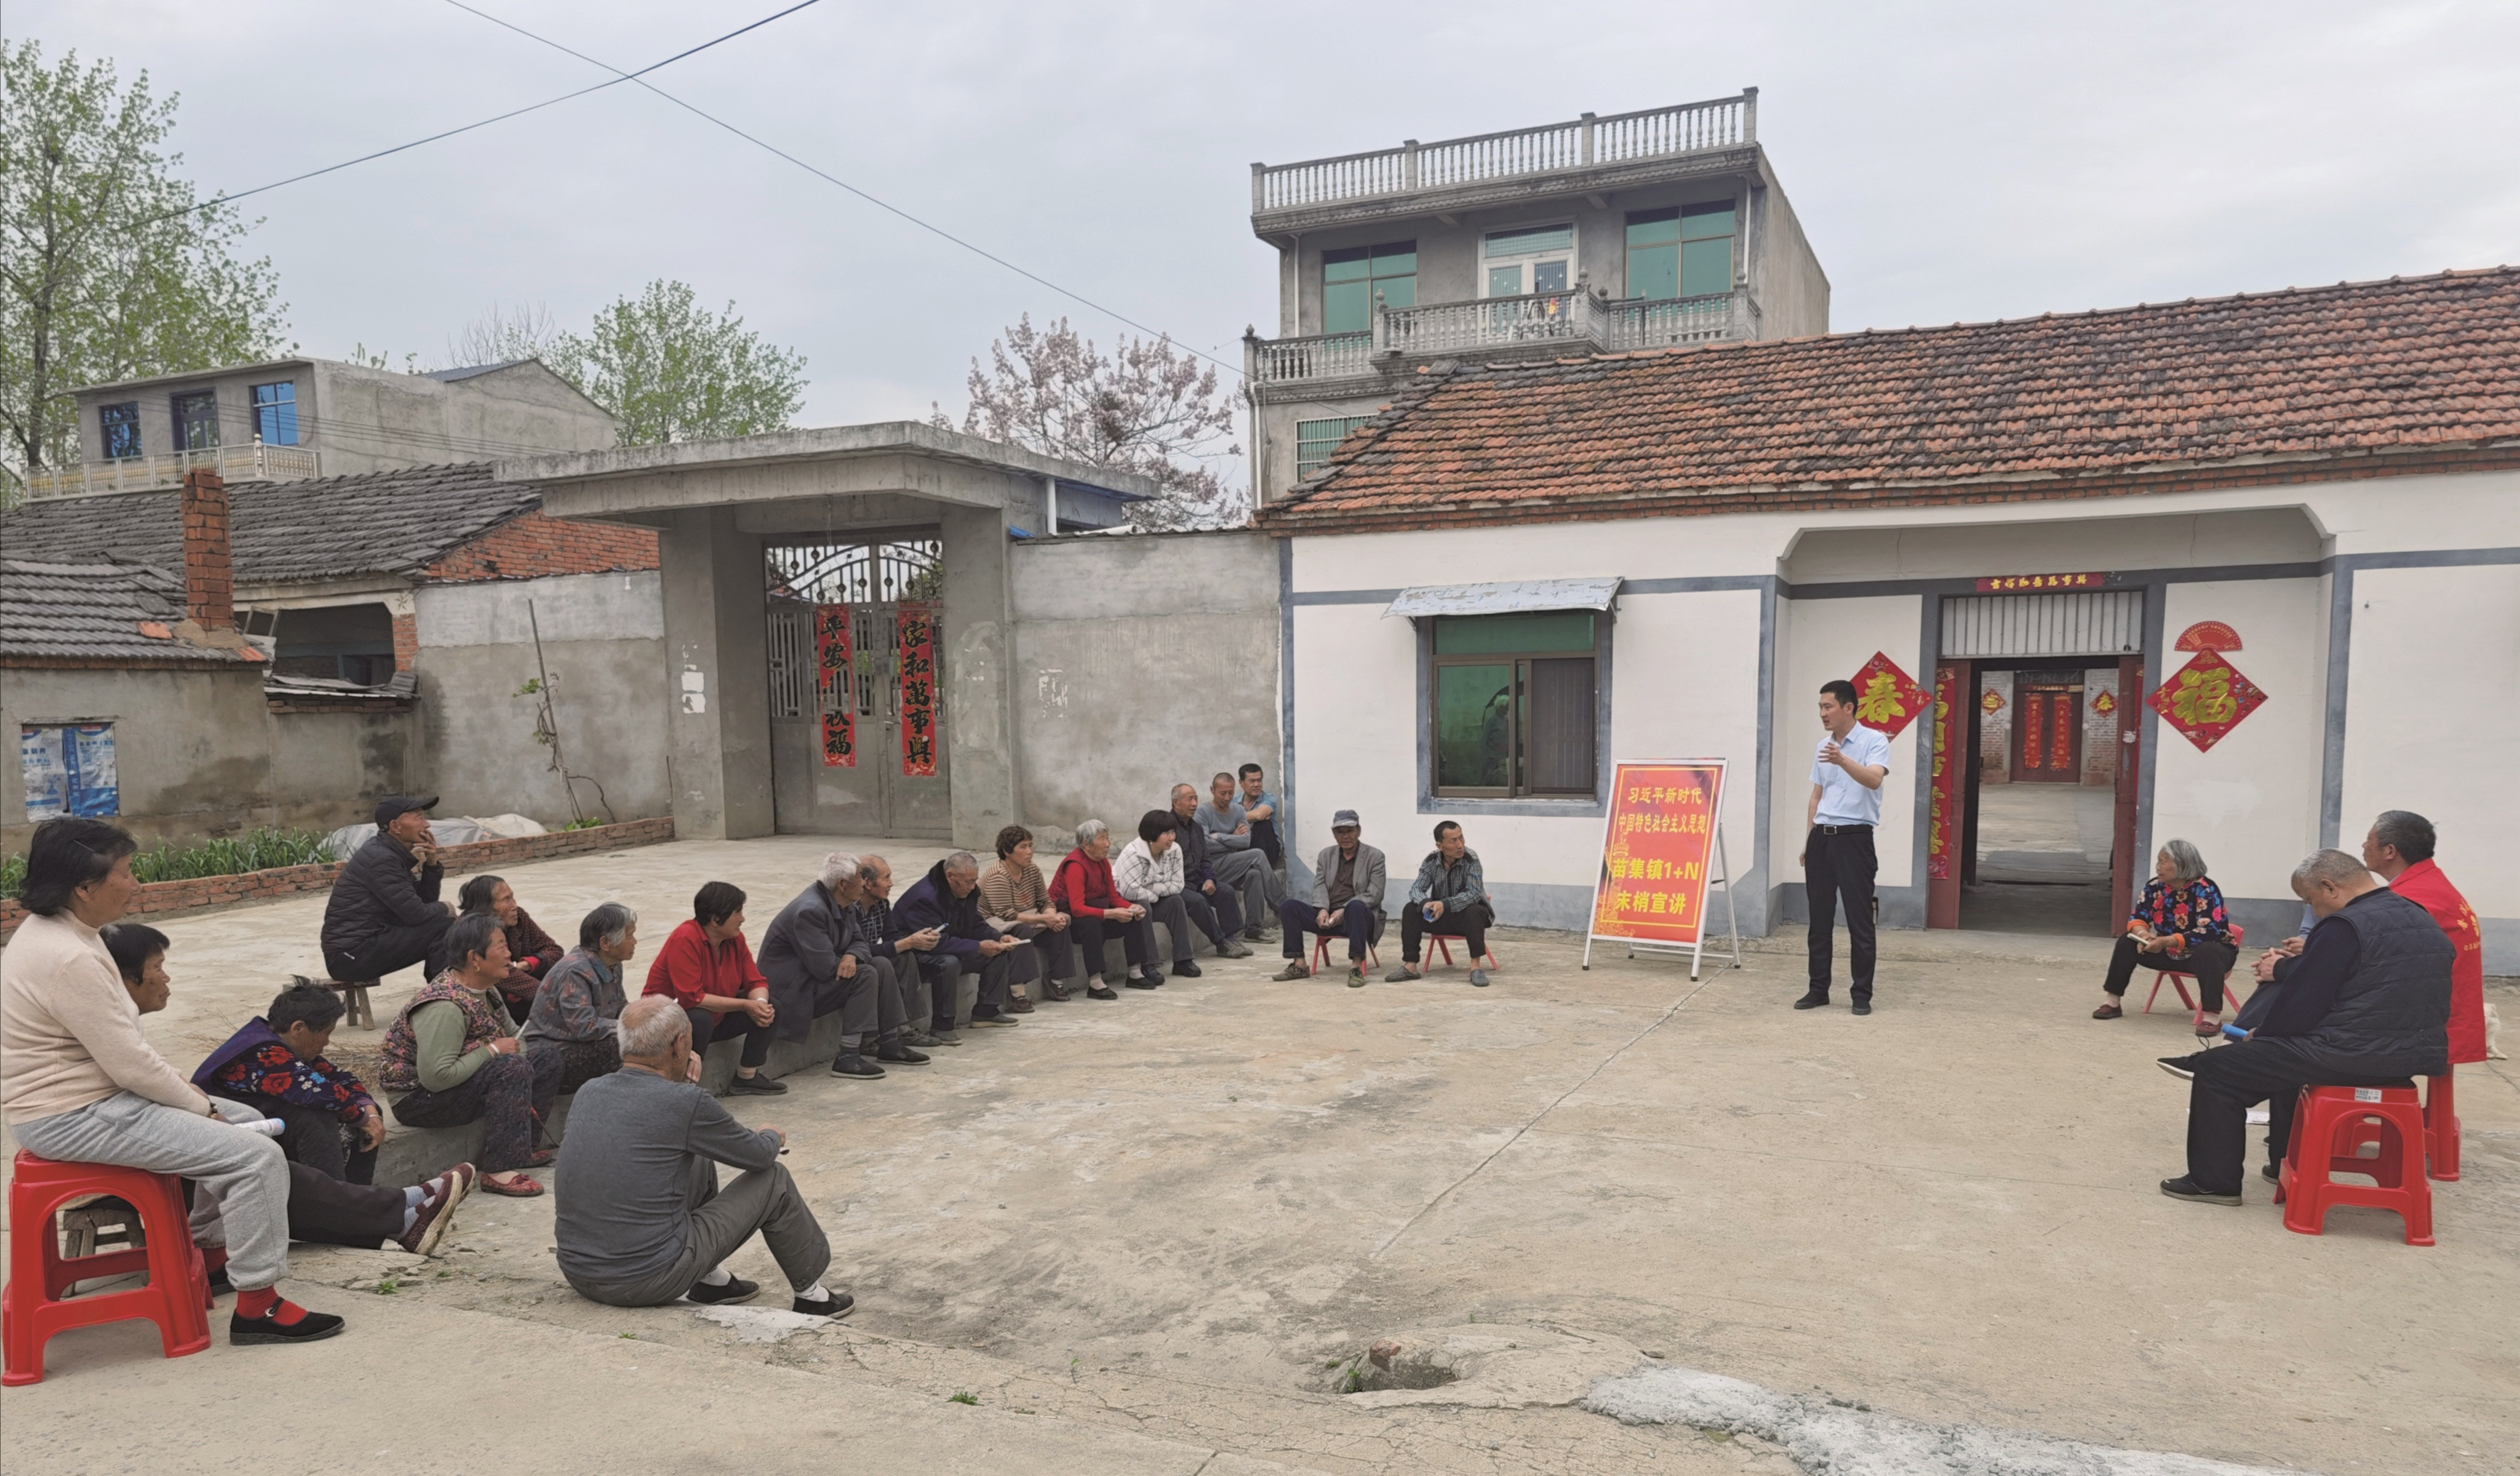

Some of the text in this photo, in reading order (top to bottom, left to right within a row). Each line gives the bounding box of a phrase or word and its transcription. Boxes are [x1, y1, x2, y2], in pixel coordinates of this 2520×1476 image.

[1855, 670, 1906, 724] 春
[2171, 666, 2238, 727] 福
[1628, 786, 1702, 805] 习近平新时代
[1618, 812, 1706, 835] 中国特色社会主义思想
[1612, 857, 1700, 880] 苗集镇1+N
[1616, 890, 1686, 916] 末梢宣讲
